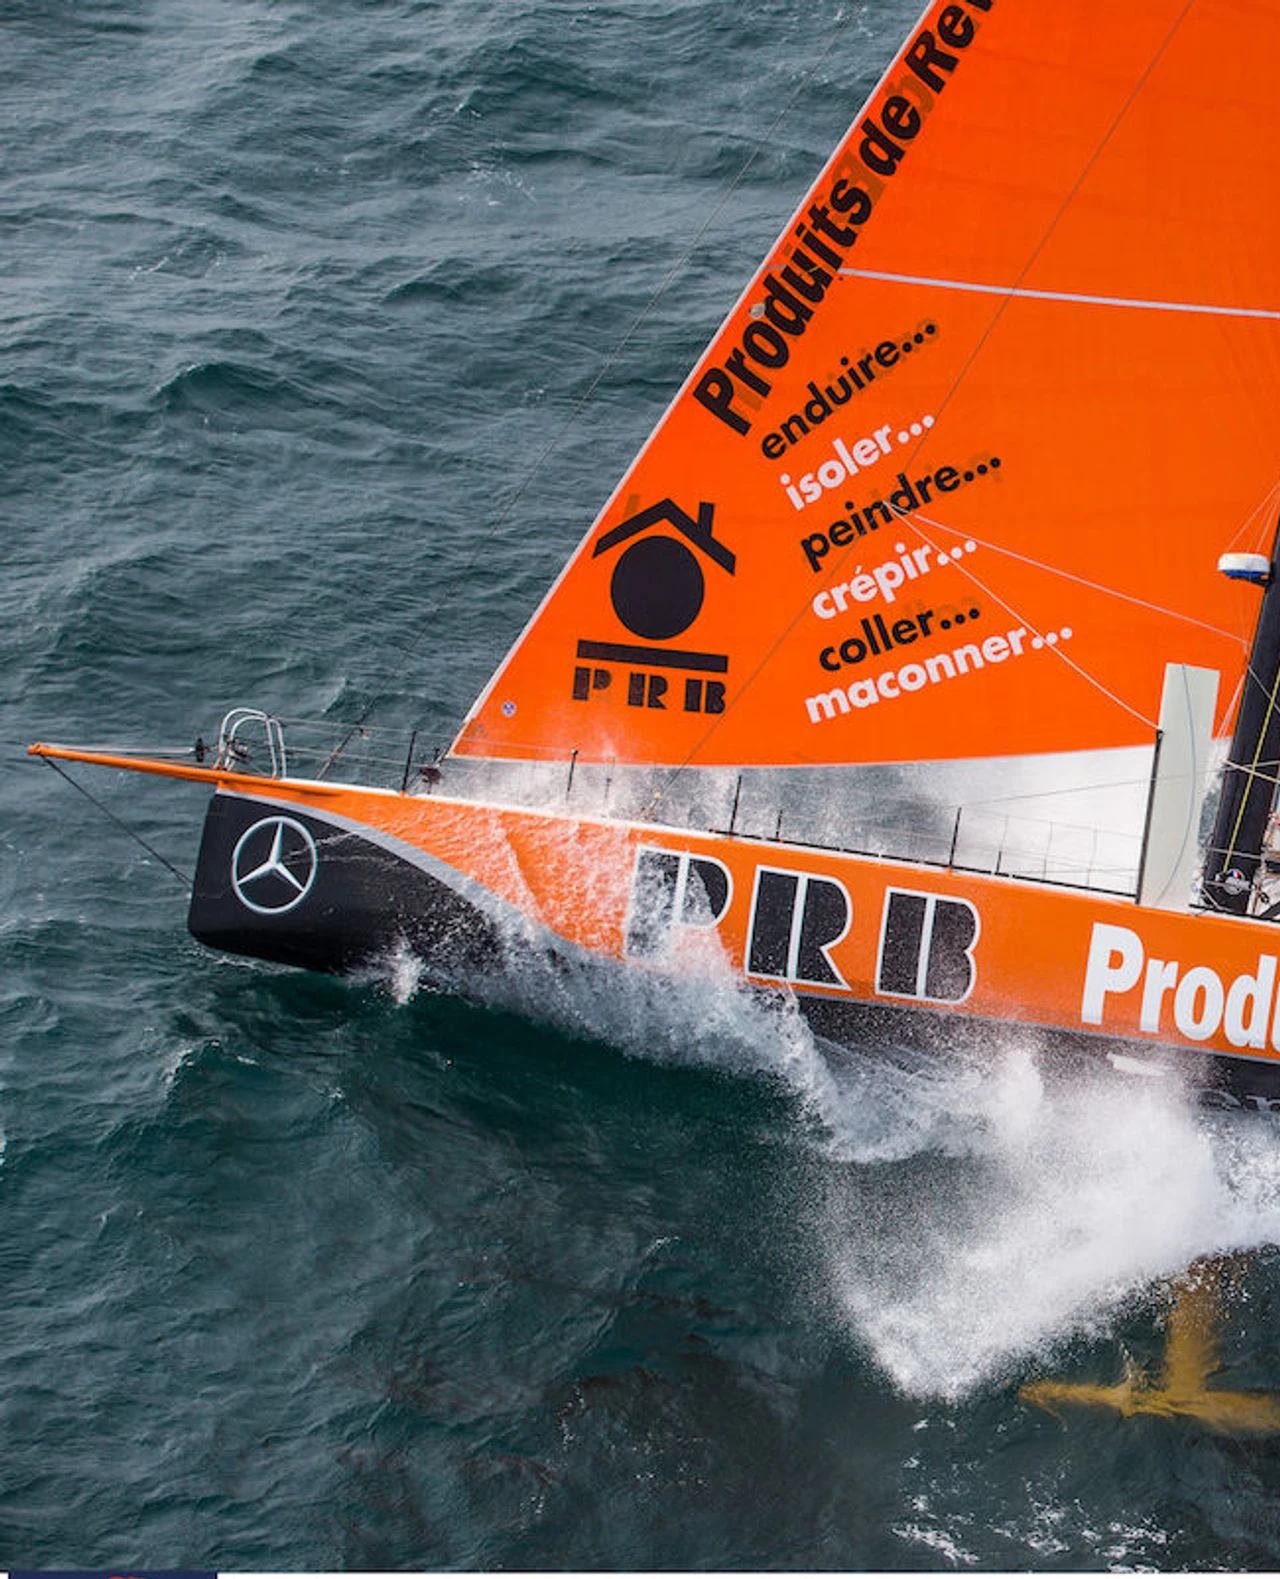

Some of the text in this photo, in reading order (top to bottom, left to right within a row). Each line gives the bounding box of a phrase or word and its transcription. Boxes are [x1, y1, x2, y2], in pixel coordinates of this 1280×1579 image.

[692, 178, 873, 437] Produits
[858, 95, 921, 176] de
[760, 322, 937, 460] enduire...
[780, 414, 935, 511] isoler...
[800, 456, 1001, 572] peindre...
[811, 540, 977, 622] crépir...
[805, 626, 1073, 725] maconner...
[818, 606, 981, 673] coller...
[572, 666, 727, 715] PRB
[624, 845, 982, 1005] PRB
